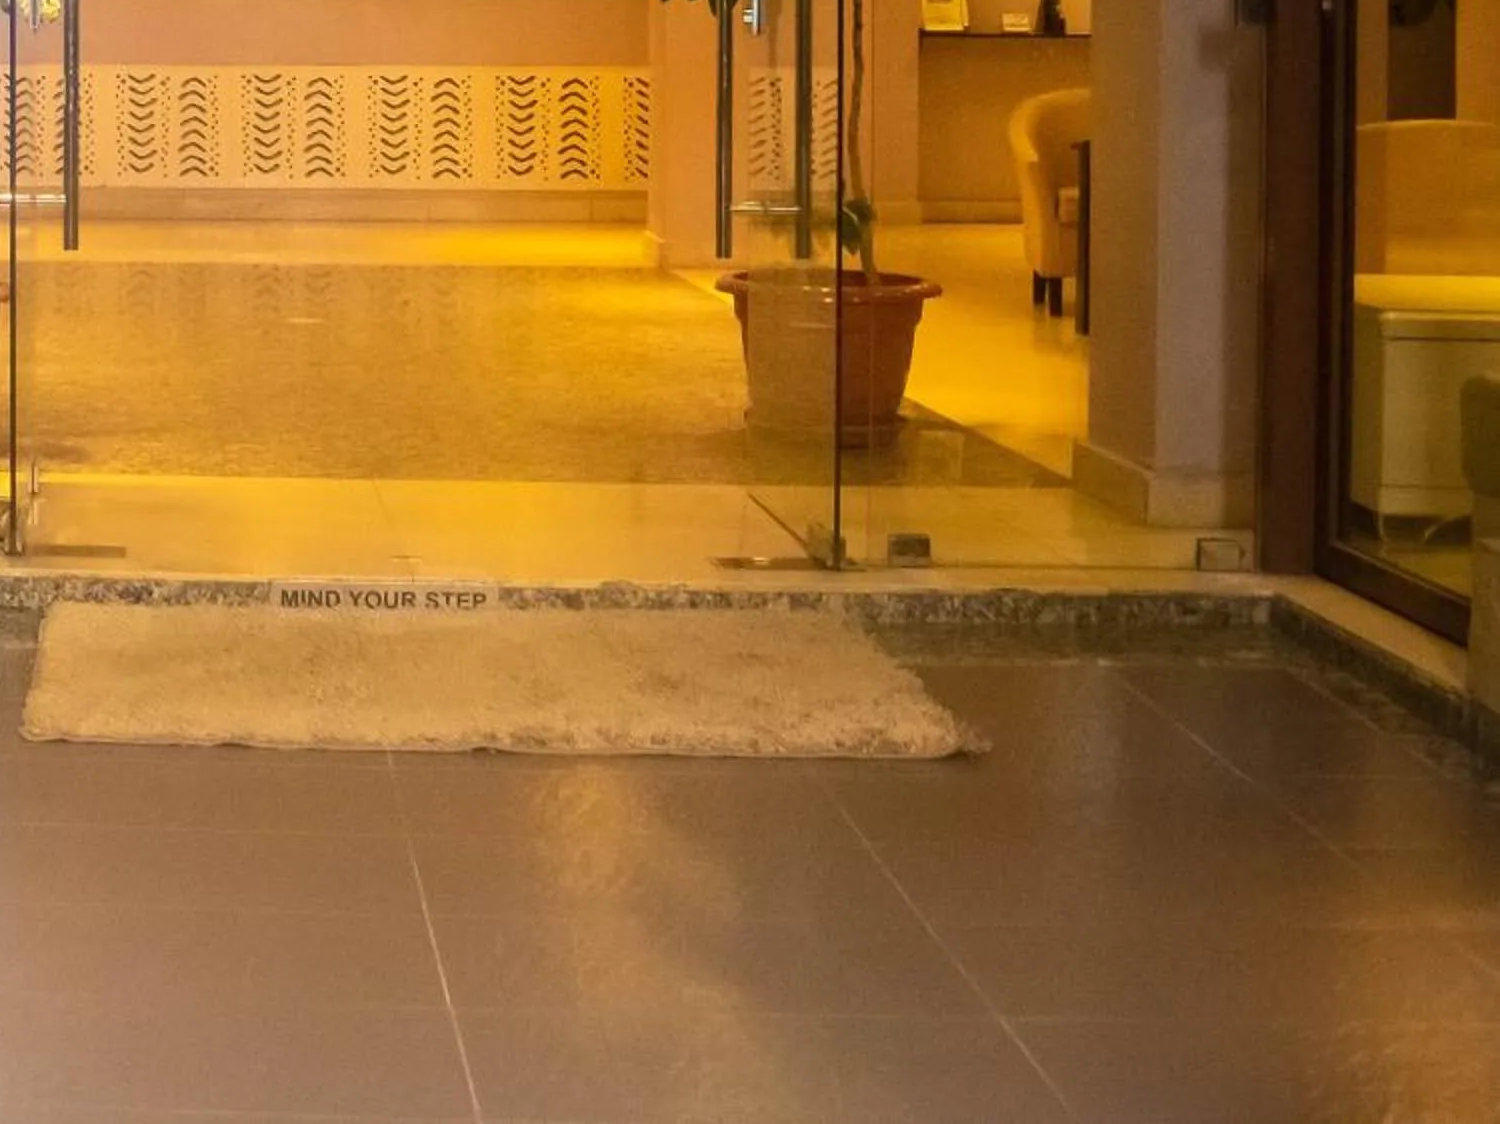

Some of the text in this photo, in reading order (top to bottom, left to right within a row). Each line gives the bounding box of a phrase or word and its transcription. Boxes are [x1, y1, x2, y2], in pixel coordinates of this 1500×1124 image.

[280, 588, 487, 610] MIND YOUR STEP
